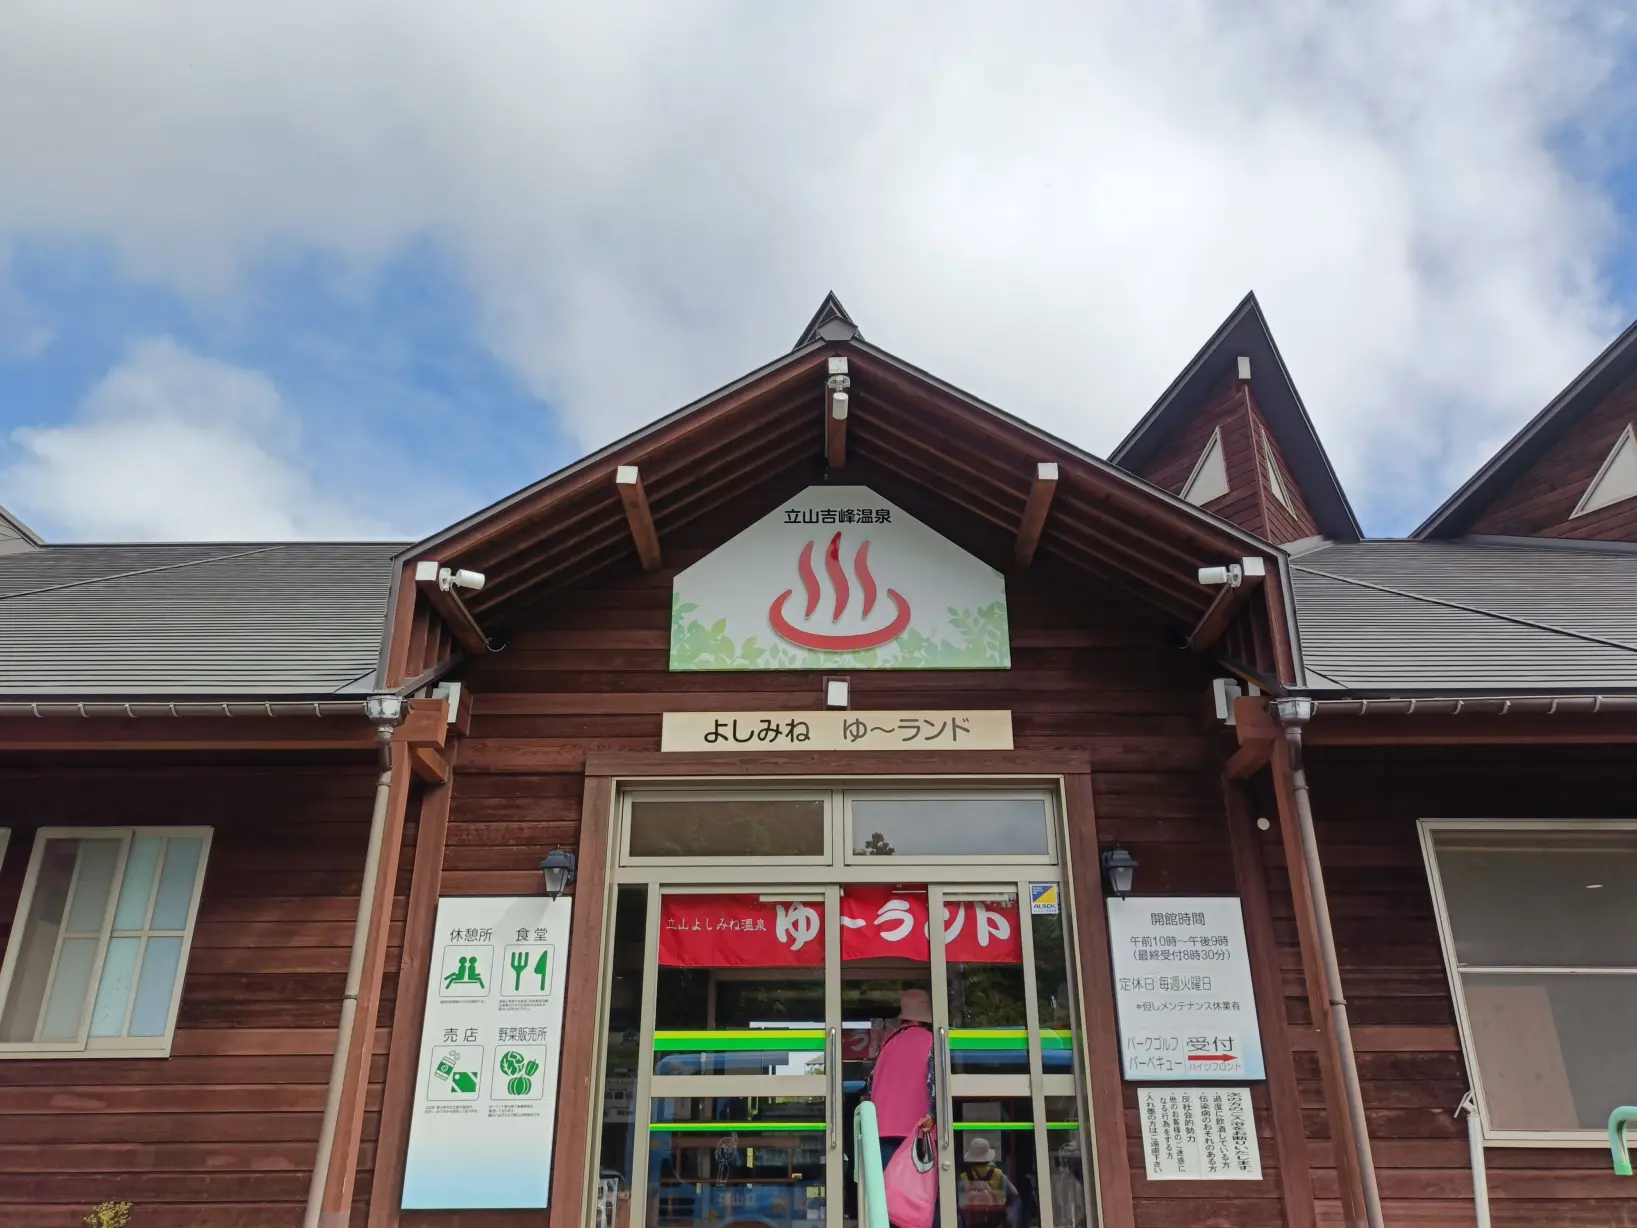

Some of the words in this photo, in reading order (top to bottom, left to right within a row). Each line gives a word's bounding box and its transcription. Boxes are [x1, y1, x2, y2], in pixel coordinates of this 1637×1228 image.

[784, 508, 892, 524] 立山吉峰温泉
[703, 718, 811, 742] よしみね
[843, 717, 971, 742] ゆ～ランド
[666, 918, 767, 932] 立山よしみね温泉
[1150, 912, 1206, 926] 開館時間
[449, 927, 493, 942] 休憩所
[515, 927, 548, 942] 食堂
[1119, 977, 1155, 992] 定休日
[1158, 976, 1212, 991] 毎週火曜日
[443, 1027, 479, 1043] 売店
[498, 1026, 548, 1042] 野菜販売所
[1186, 1036, 1235, 1052] 受付
